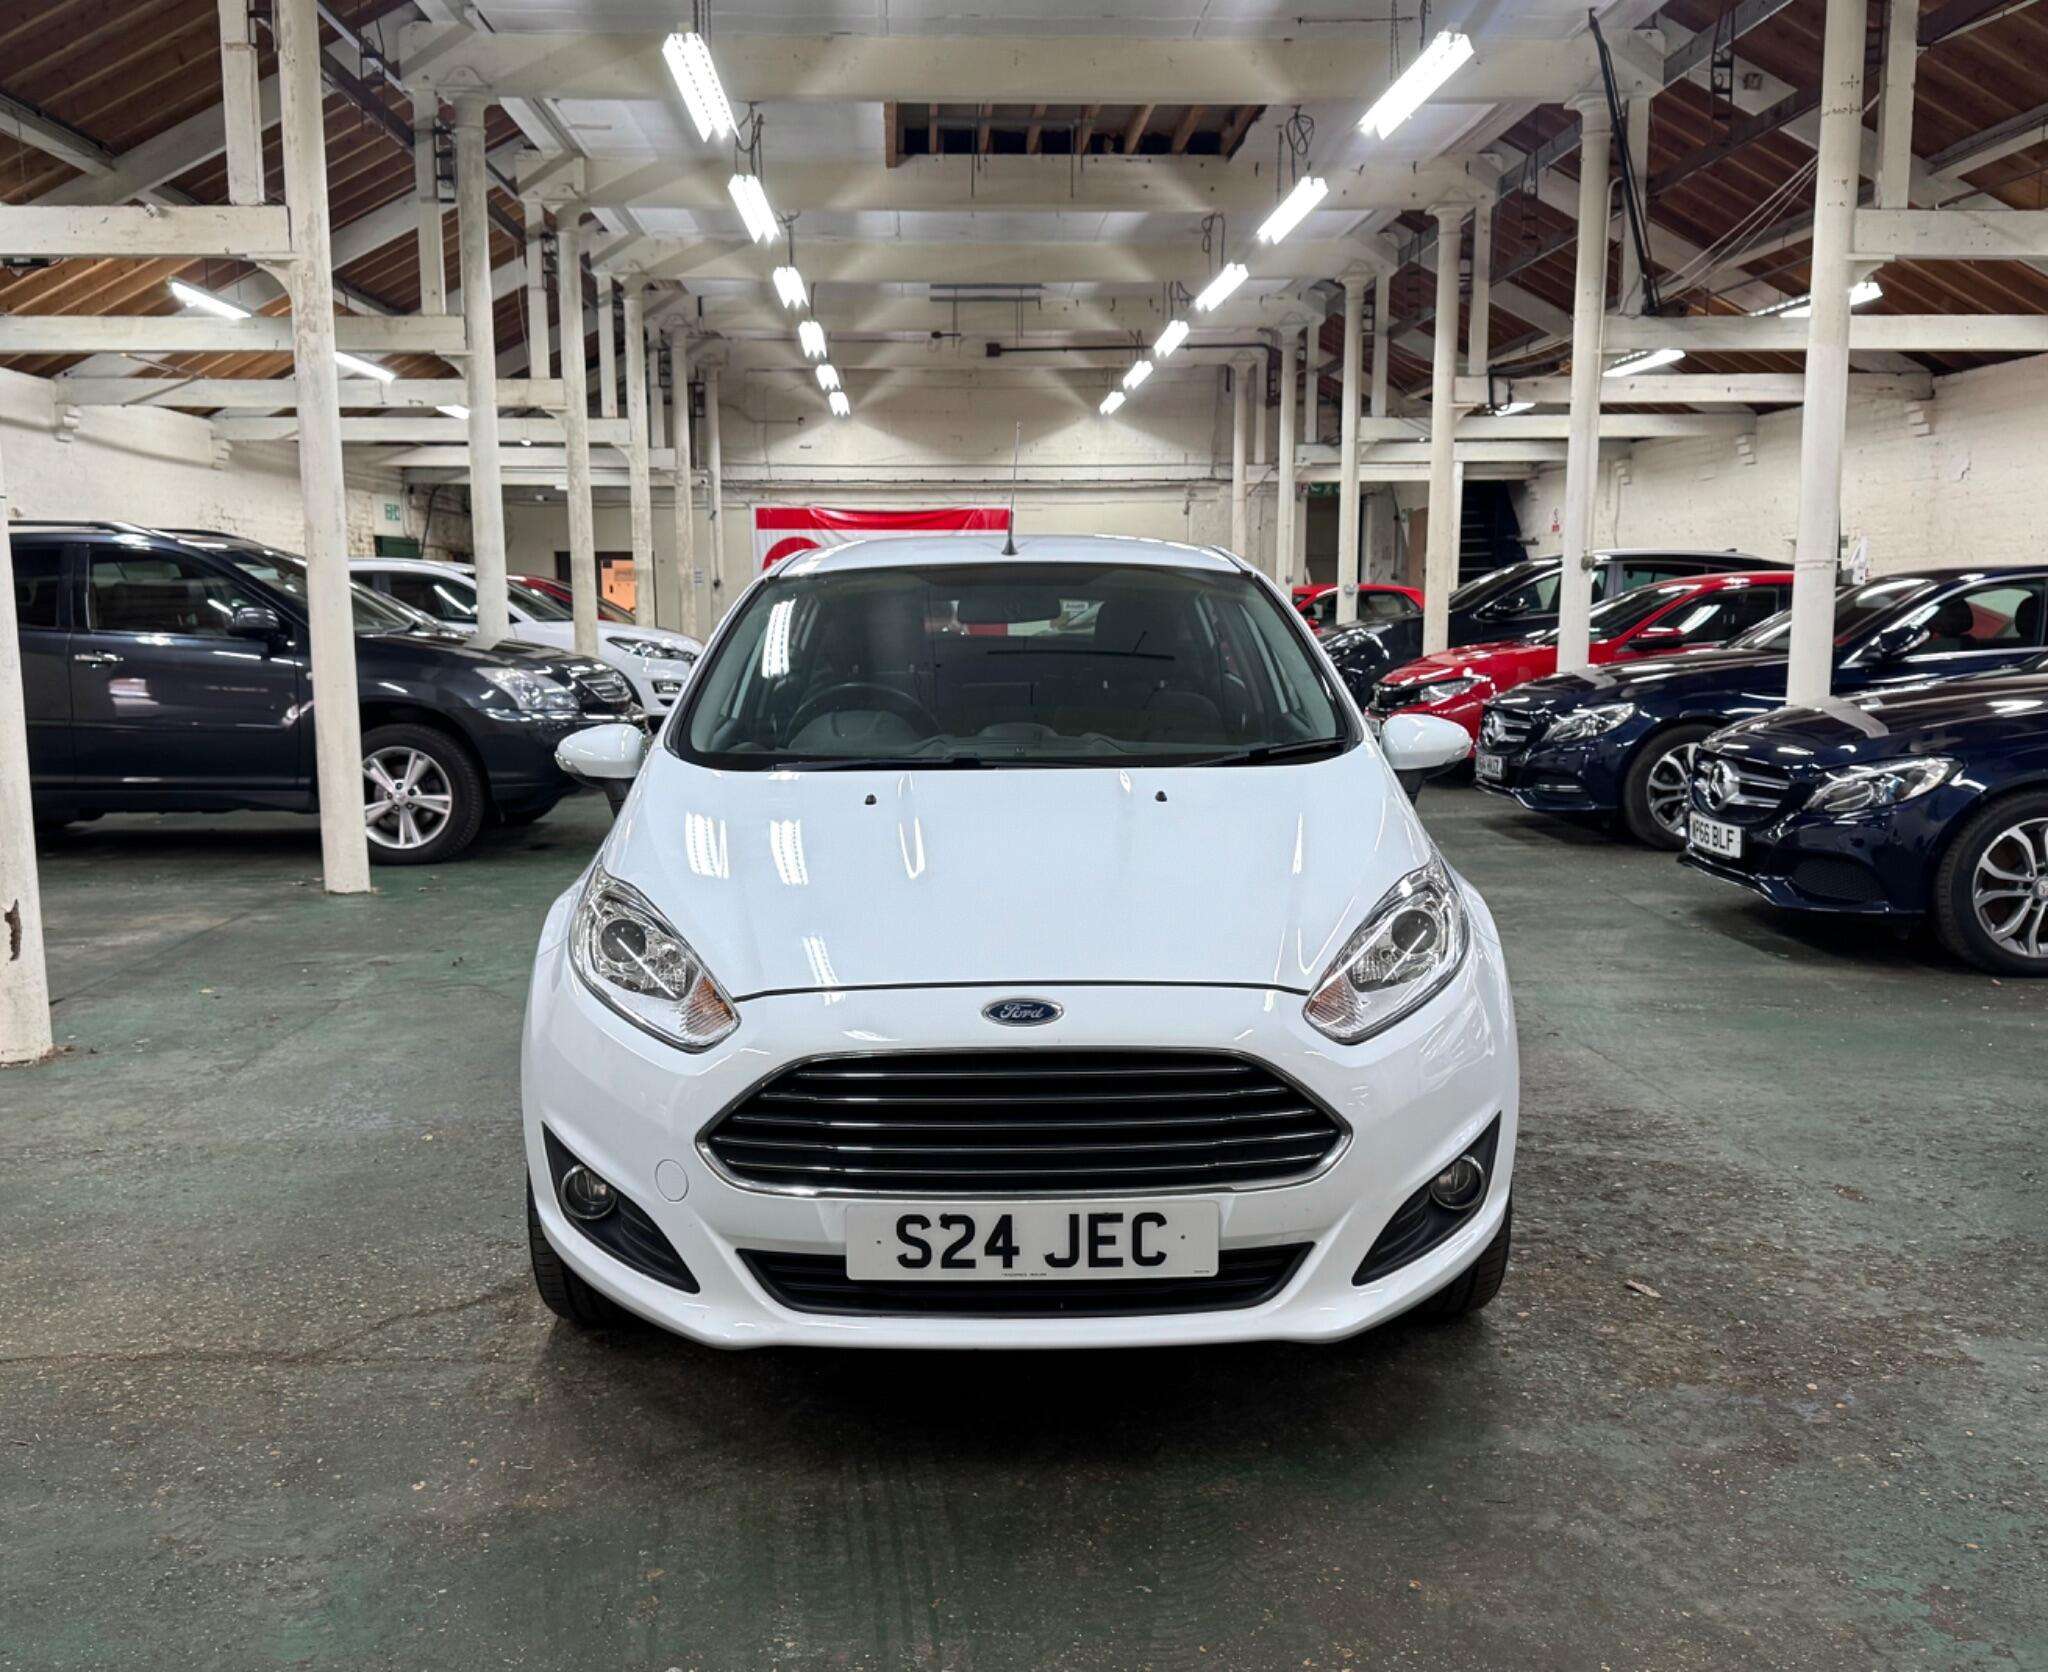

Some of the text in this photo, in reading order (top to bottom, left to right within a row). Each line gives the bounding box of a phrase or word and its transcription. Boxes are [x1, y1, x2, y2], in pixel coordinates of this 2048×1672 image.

[1712, 825, 1735, 851] BLF
[1000, 1003, 1044, 1018] Ford
[896, 1212, 1167, 1269] S24 JEC
